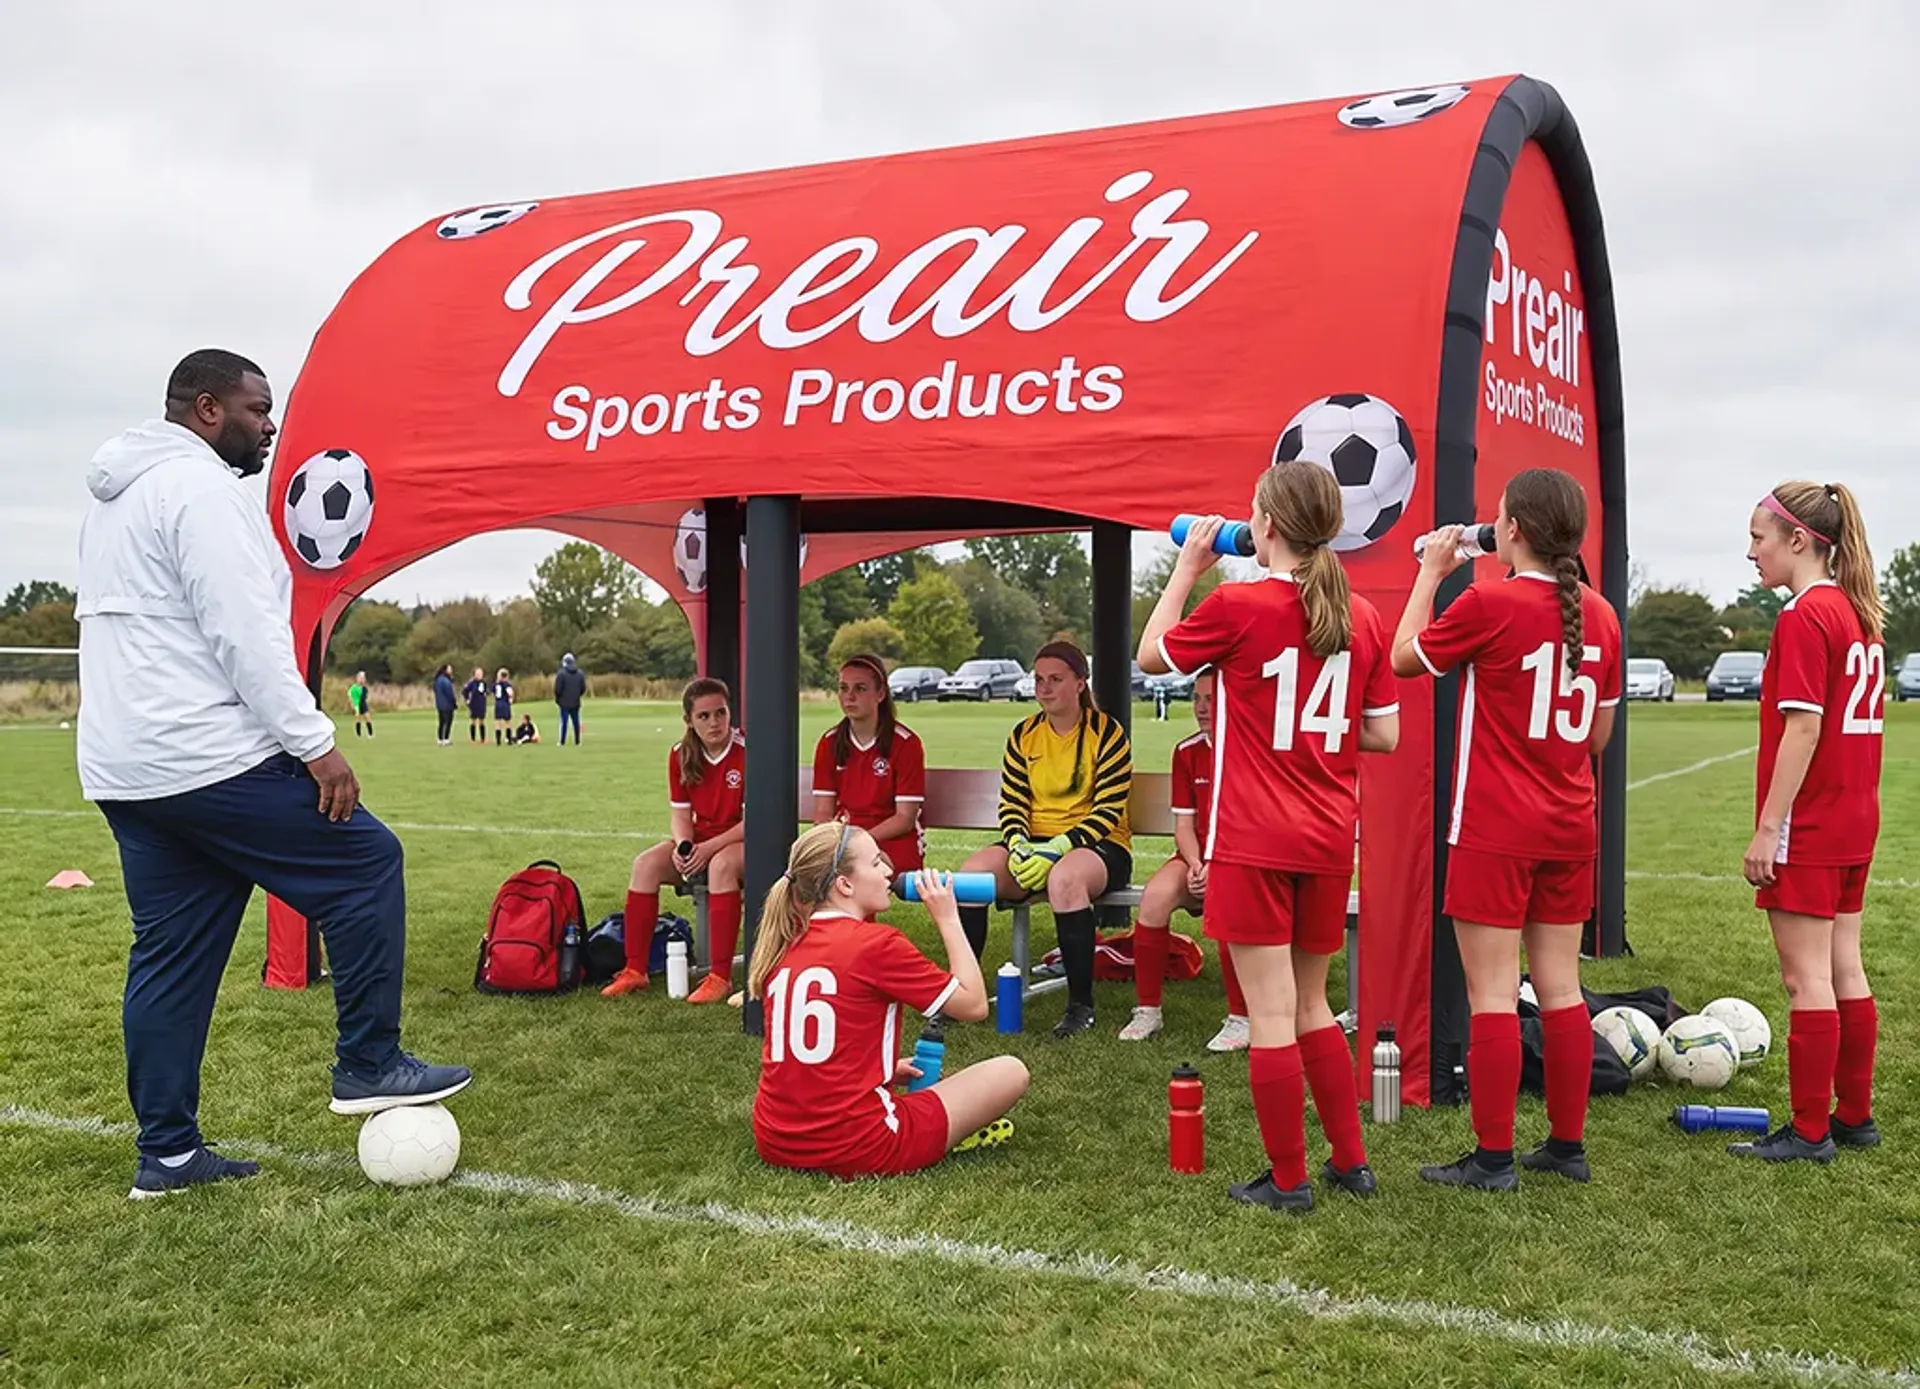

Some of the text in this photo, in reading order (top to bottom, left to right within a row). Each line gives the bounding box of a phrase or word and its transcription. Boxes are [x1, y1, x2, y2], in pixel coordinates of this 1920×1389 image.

[497, 170, 1259, 397] Preair
[1485, 228, 1584, 387] Preair
[546, 357, 1123, 451] Sports Products
[1485, 361, 1584, 446] Sports Products
[1262, 647, 1351, 753] 14
[1521, 641, 1602, 743] 15
[1842, 641, 1885, 734] 22
[767, 967, 837, 1064] 16
